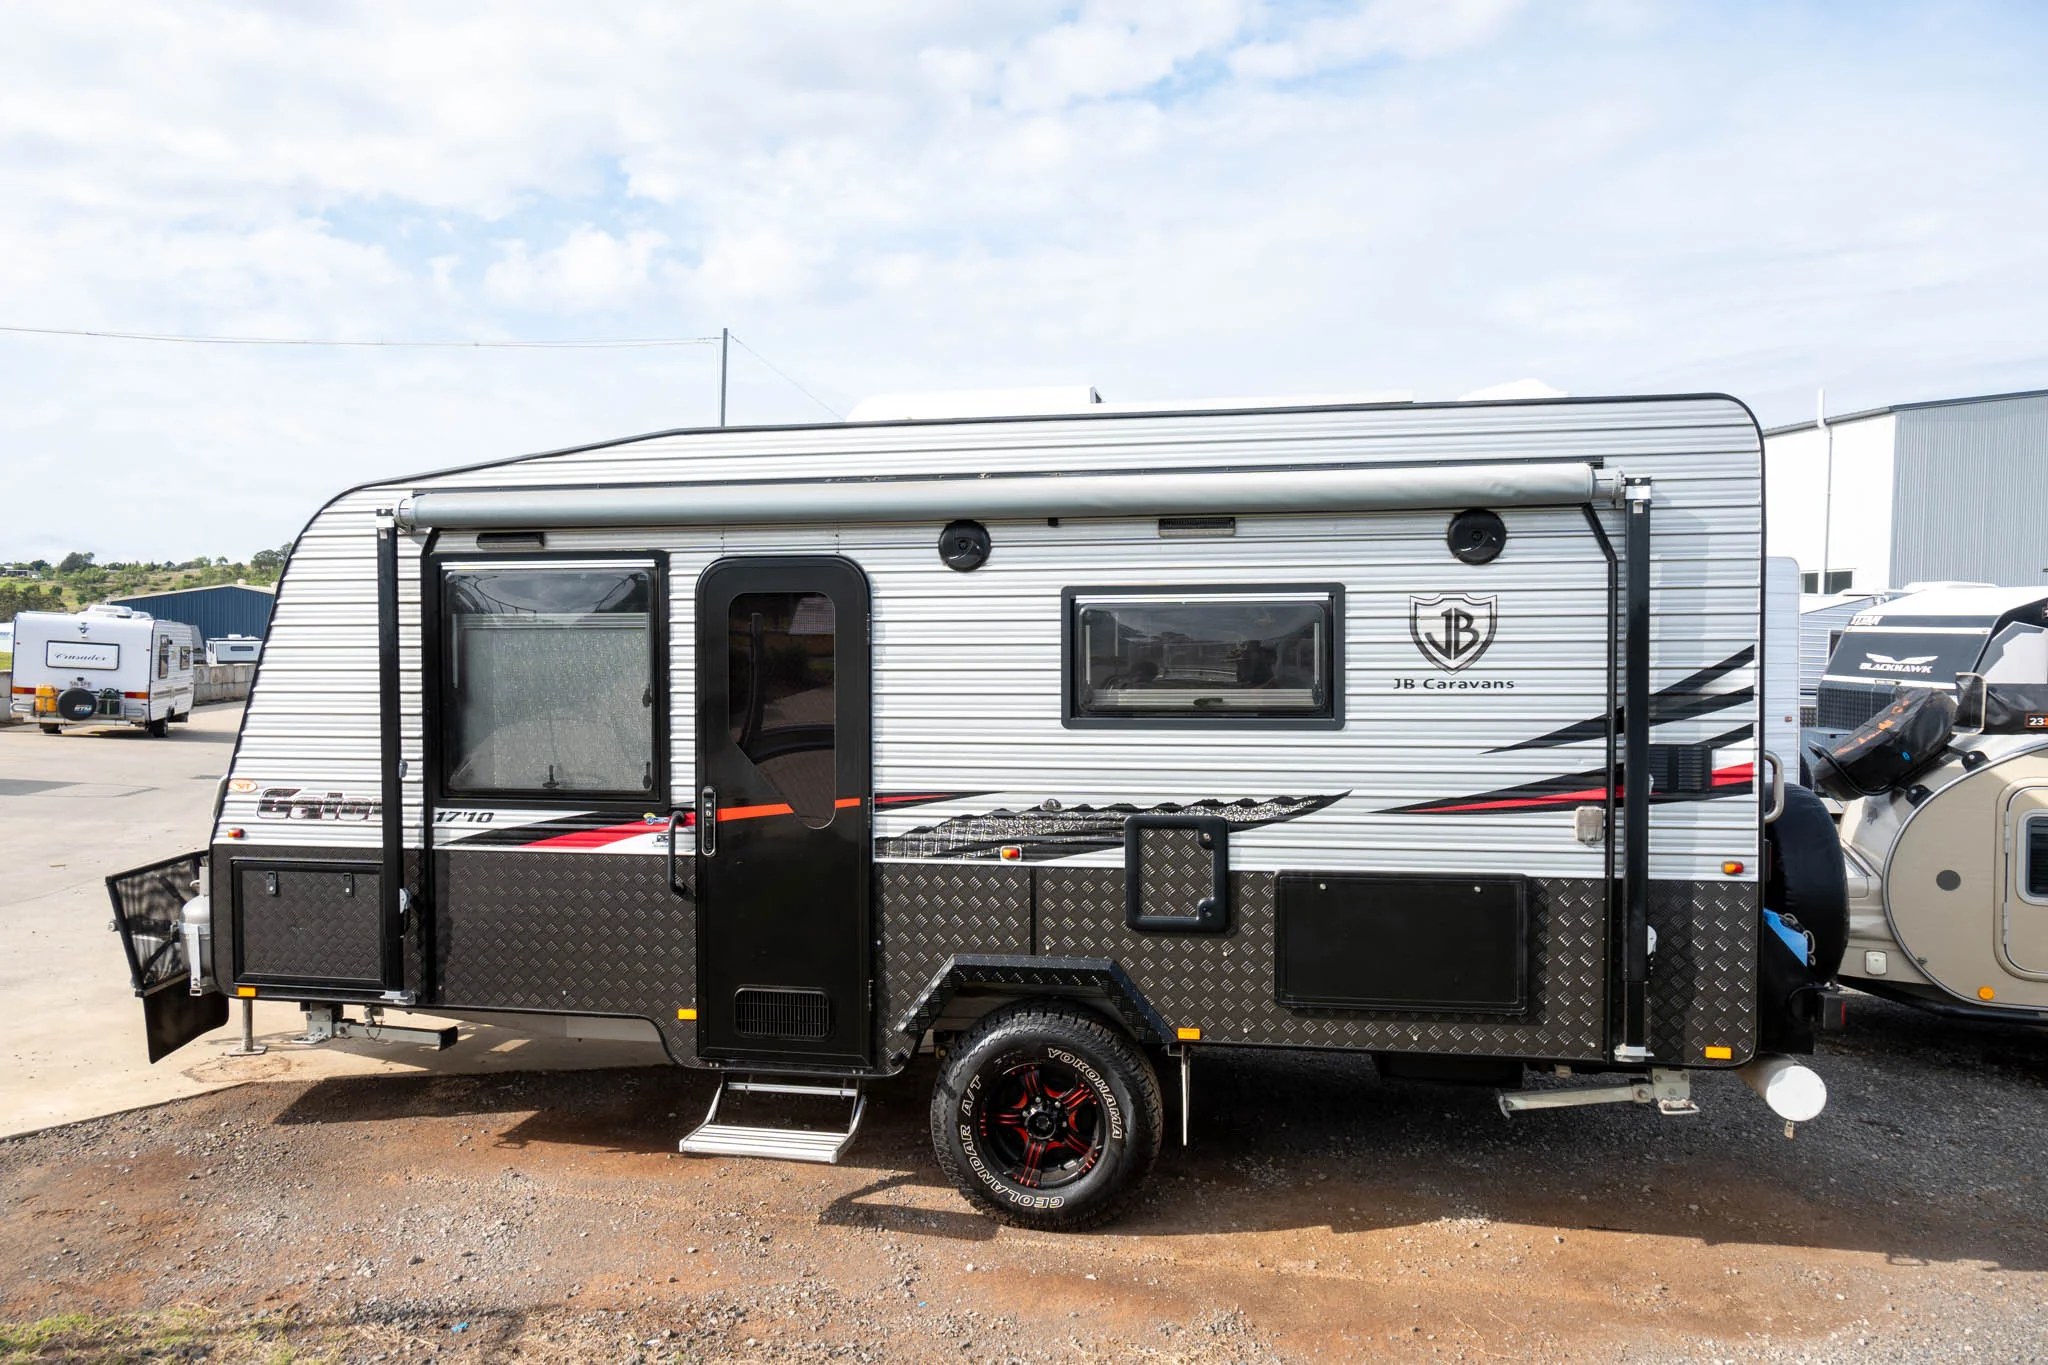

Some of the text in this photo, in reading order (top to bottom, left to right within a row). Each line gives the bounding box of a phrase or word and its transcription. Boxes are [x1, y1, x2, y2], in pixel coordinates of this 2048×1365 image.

[1425, 607, 1480, 660] JB
[1859, 662, 1933, 674] BLACKHAWK
[1393, 678, 1515, 690] JB Caravans
[2029, 716, 2048, 727] 23
[435, 811, 495, 823] 17'10
[961, 1074, 981, 1117] A/T
[1047, 1047, 1123, 1140] YOKOHAMA
[960, 1124, 1065, 1209] GEOLANDAR
